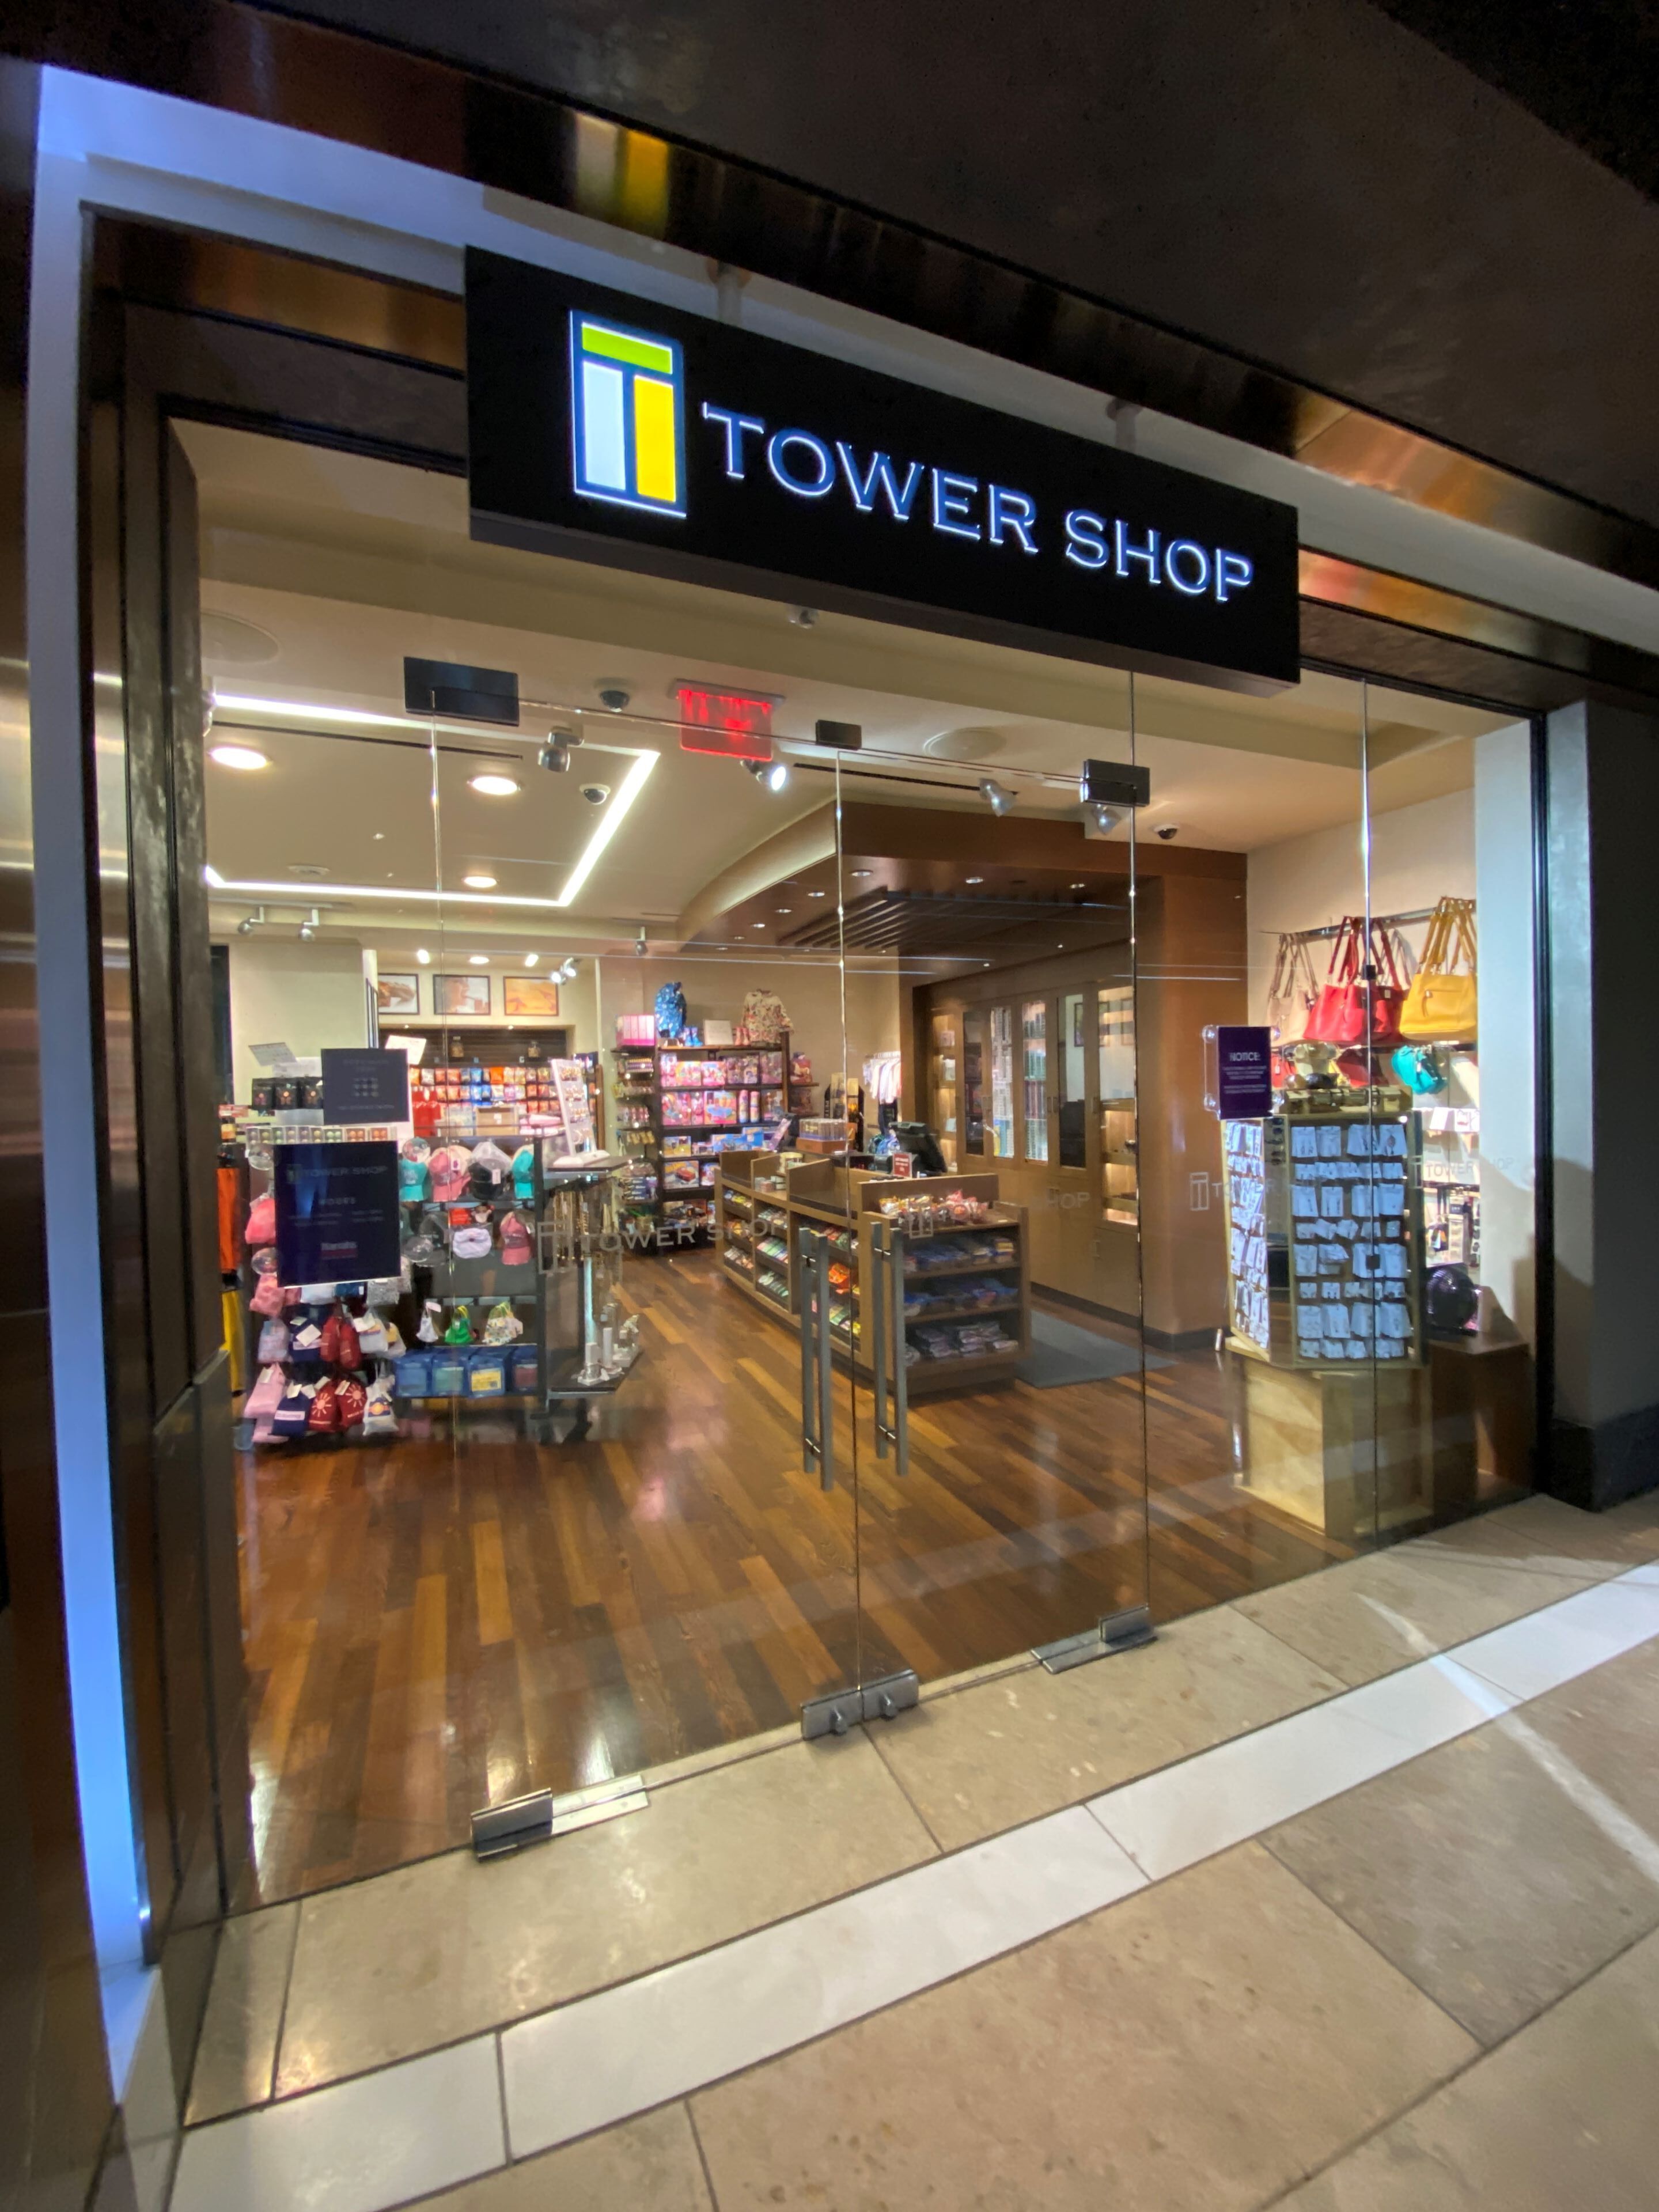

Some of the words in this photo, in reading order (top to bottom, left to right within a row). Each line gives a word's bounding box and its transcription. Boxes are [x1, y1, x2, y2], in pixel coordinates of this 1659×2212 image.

[701, 401, 1039, 552] TOWER
[1065, 510, 1252, 603] SHOP
[1426, 1161, 1474, 1178] TOWER
[579, 1225, 696, 1253] TOWER
